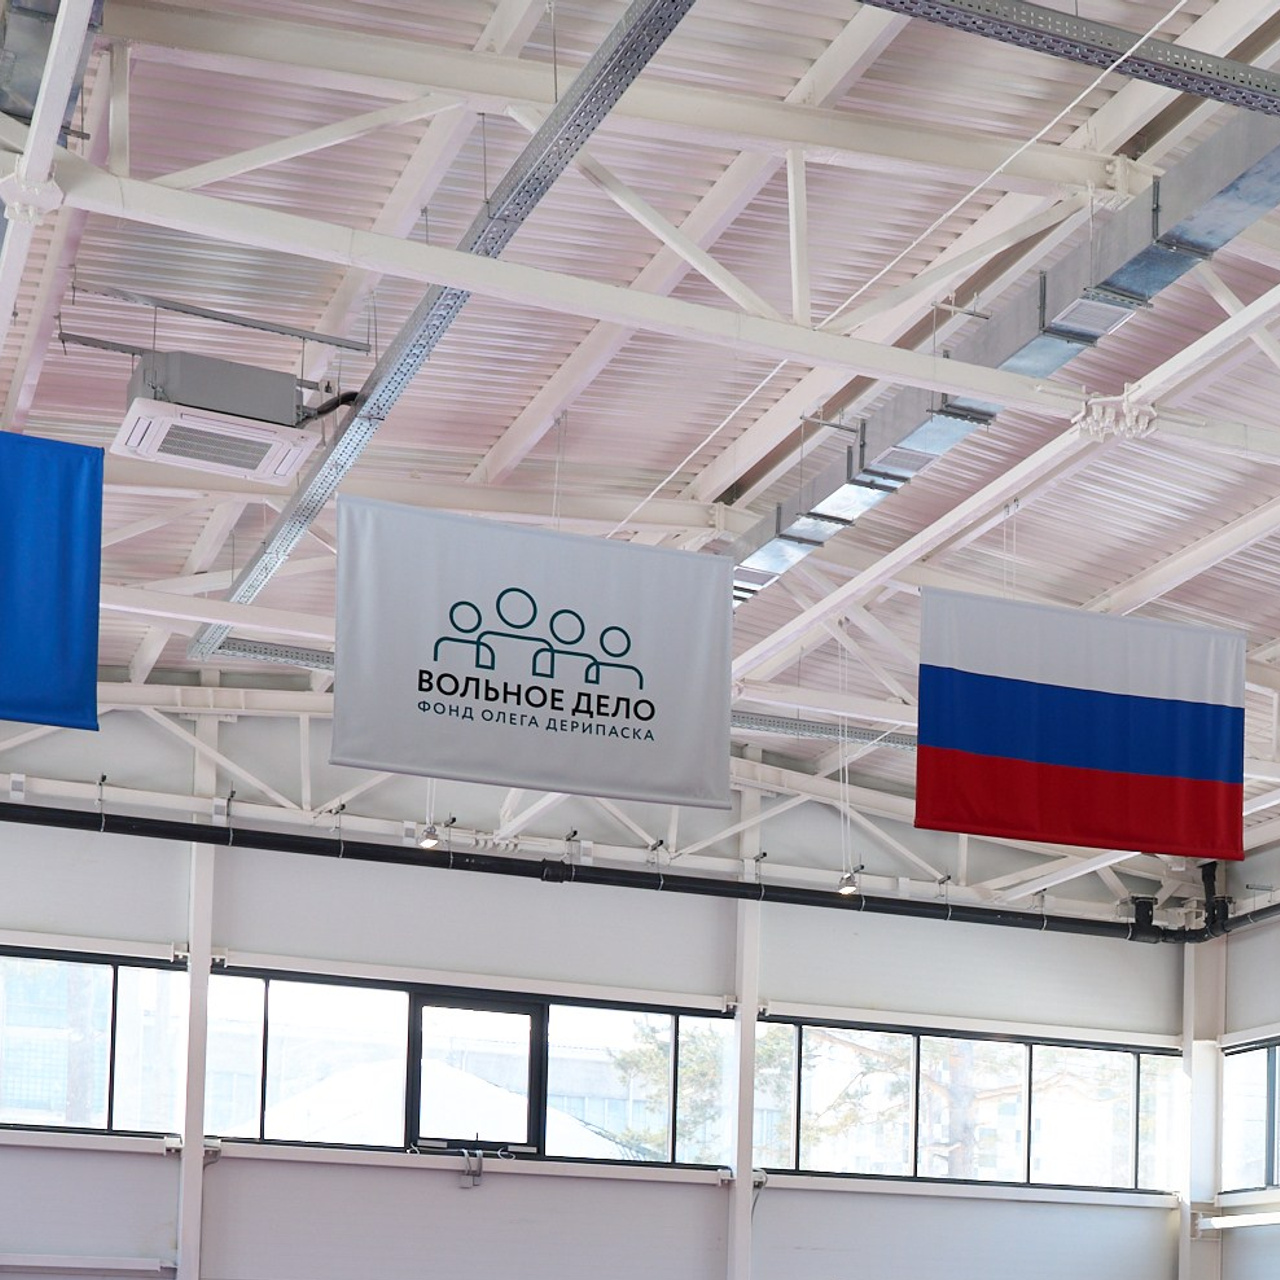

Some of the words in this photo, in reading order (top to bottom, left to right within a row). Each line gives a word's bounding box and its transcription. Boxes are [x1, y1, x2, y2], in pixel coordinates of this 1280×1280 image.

[417, 668, 565, 712] ВОЛЬНОЕ
[571, 691, 656, 722] ДЕЛО
[417, 700, 475, 722] ФОНД
[481, 708, 540, 728] ОЛЕГА
[545, 717, 655, 742] ДЕРИПАСКА
